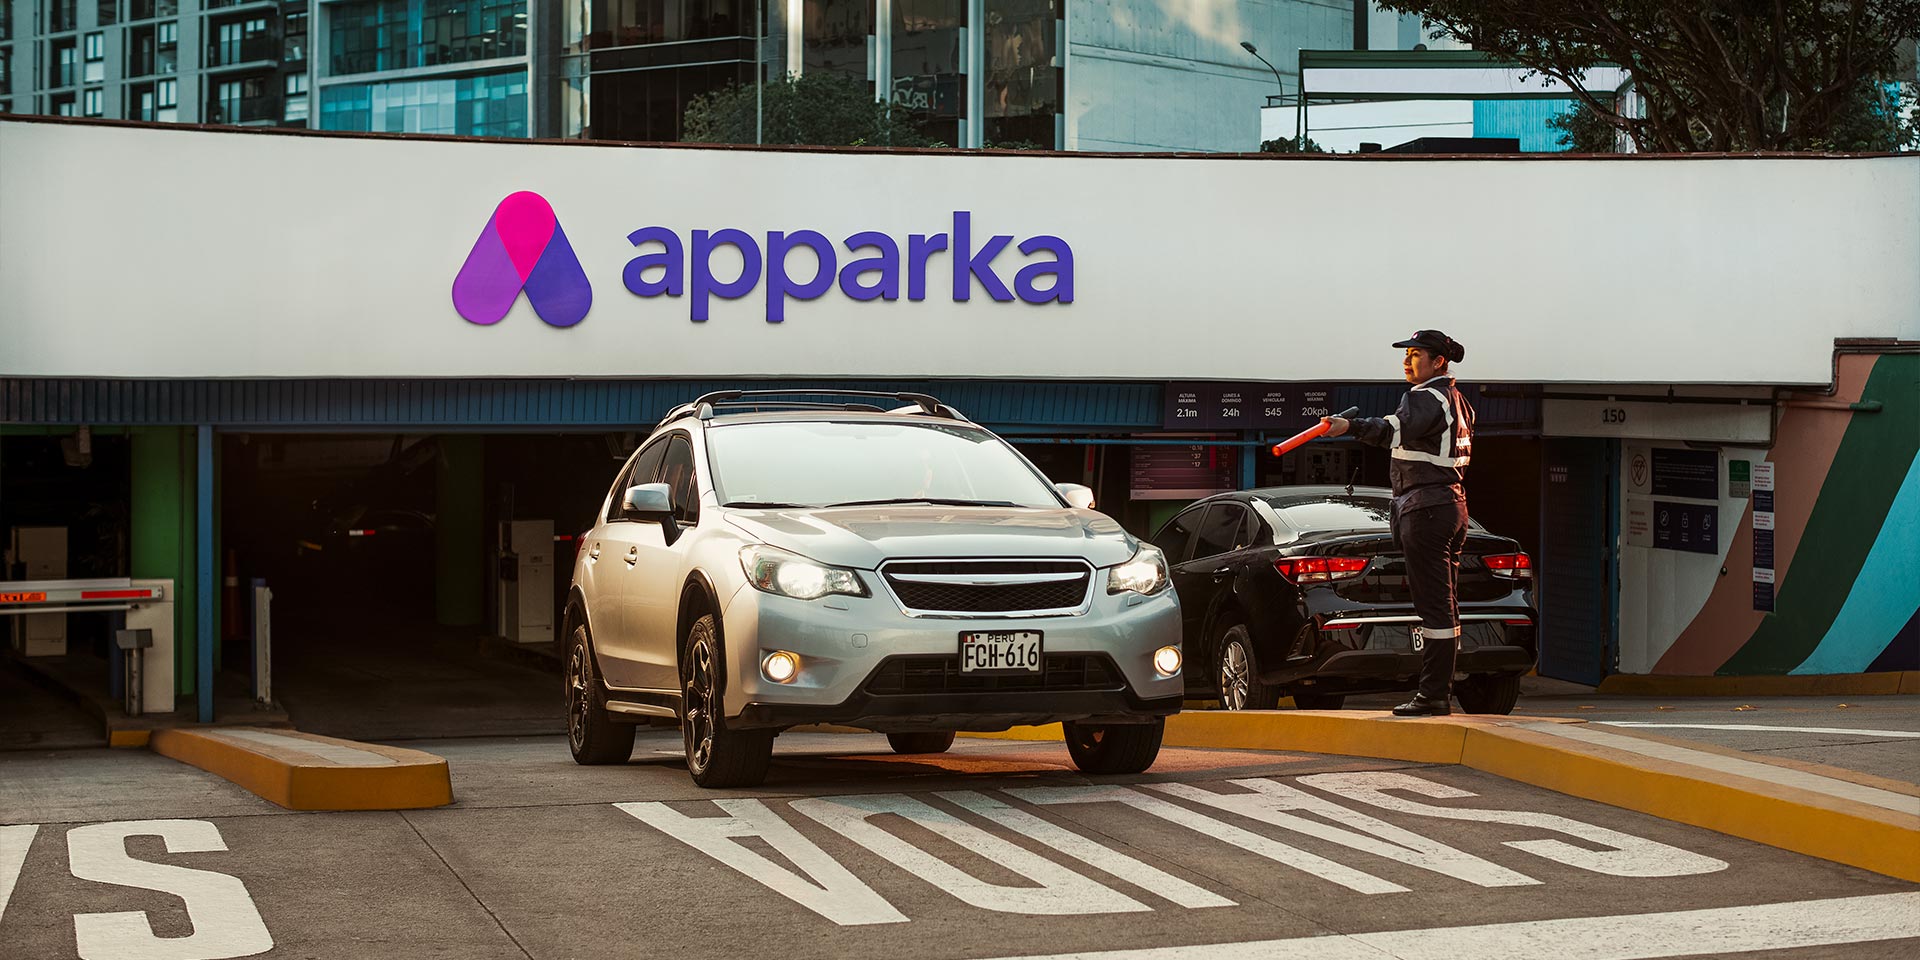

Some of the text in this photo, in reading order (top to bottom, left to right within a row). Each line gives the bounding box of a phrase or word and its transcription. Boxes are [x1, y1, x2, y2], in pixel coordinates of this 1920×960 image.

[622, 211, 1075, 323] apparka
[1176, 408, 1198, 418] 2.1m
[1222, 408, 1240, 417] 24h
[1265, 408, 1282, 417] 545
[1302, 407, 1329, 418] 20kph
[1602, 408, 1627, 424] 150
[987, 633, 1016, 643] PERU
[964, 642, 1038, 668] FCH-616
[611, 771, 1730, 927] SALIDA
